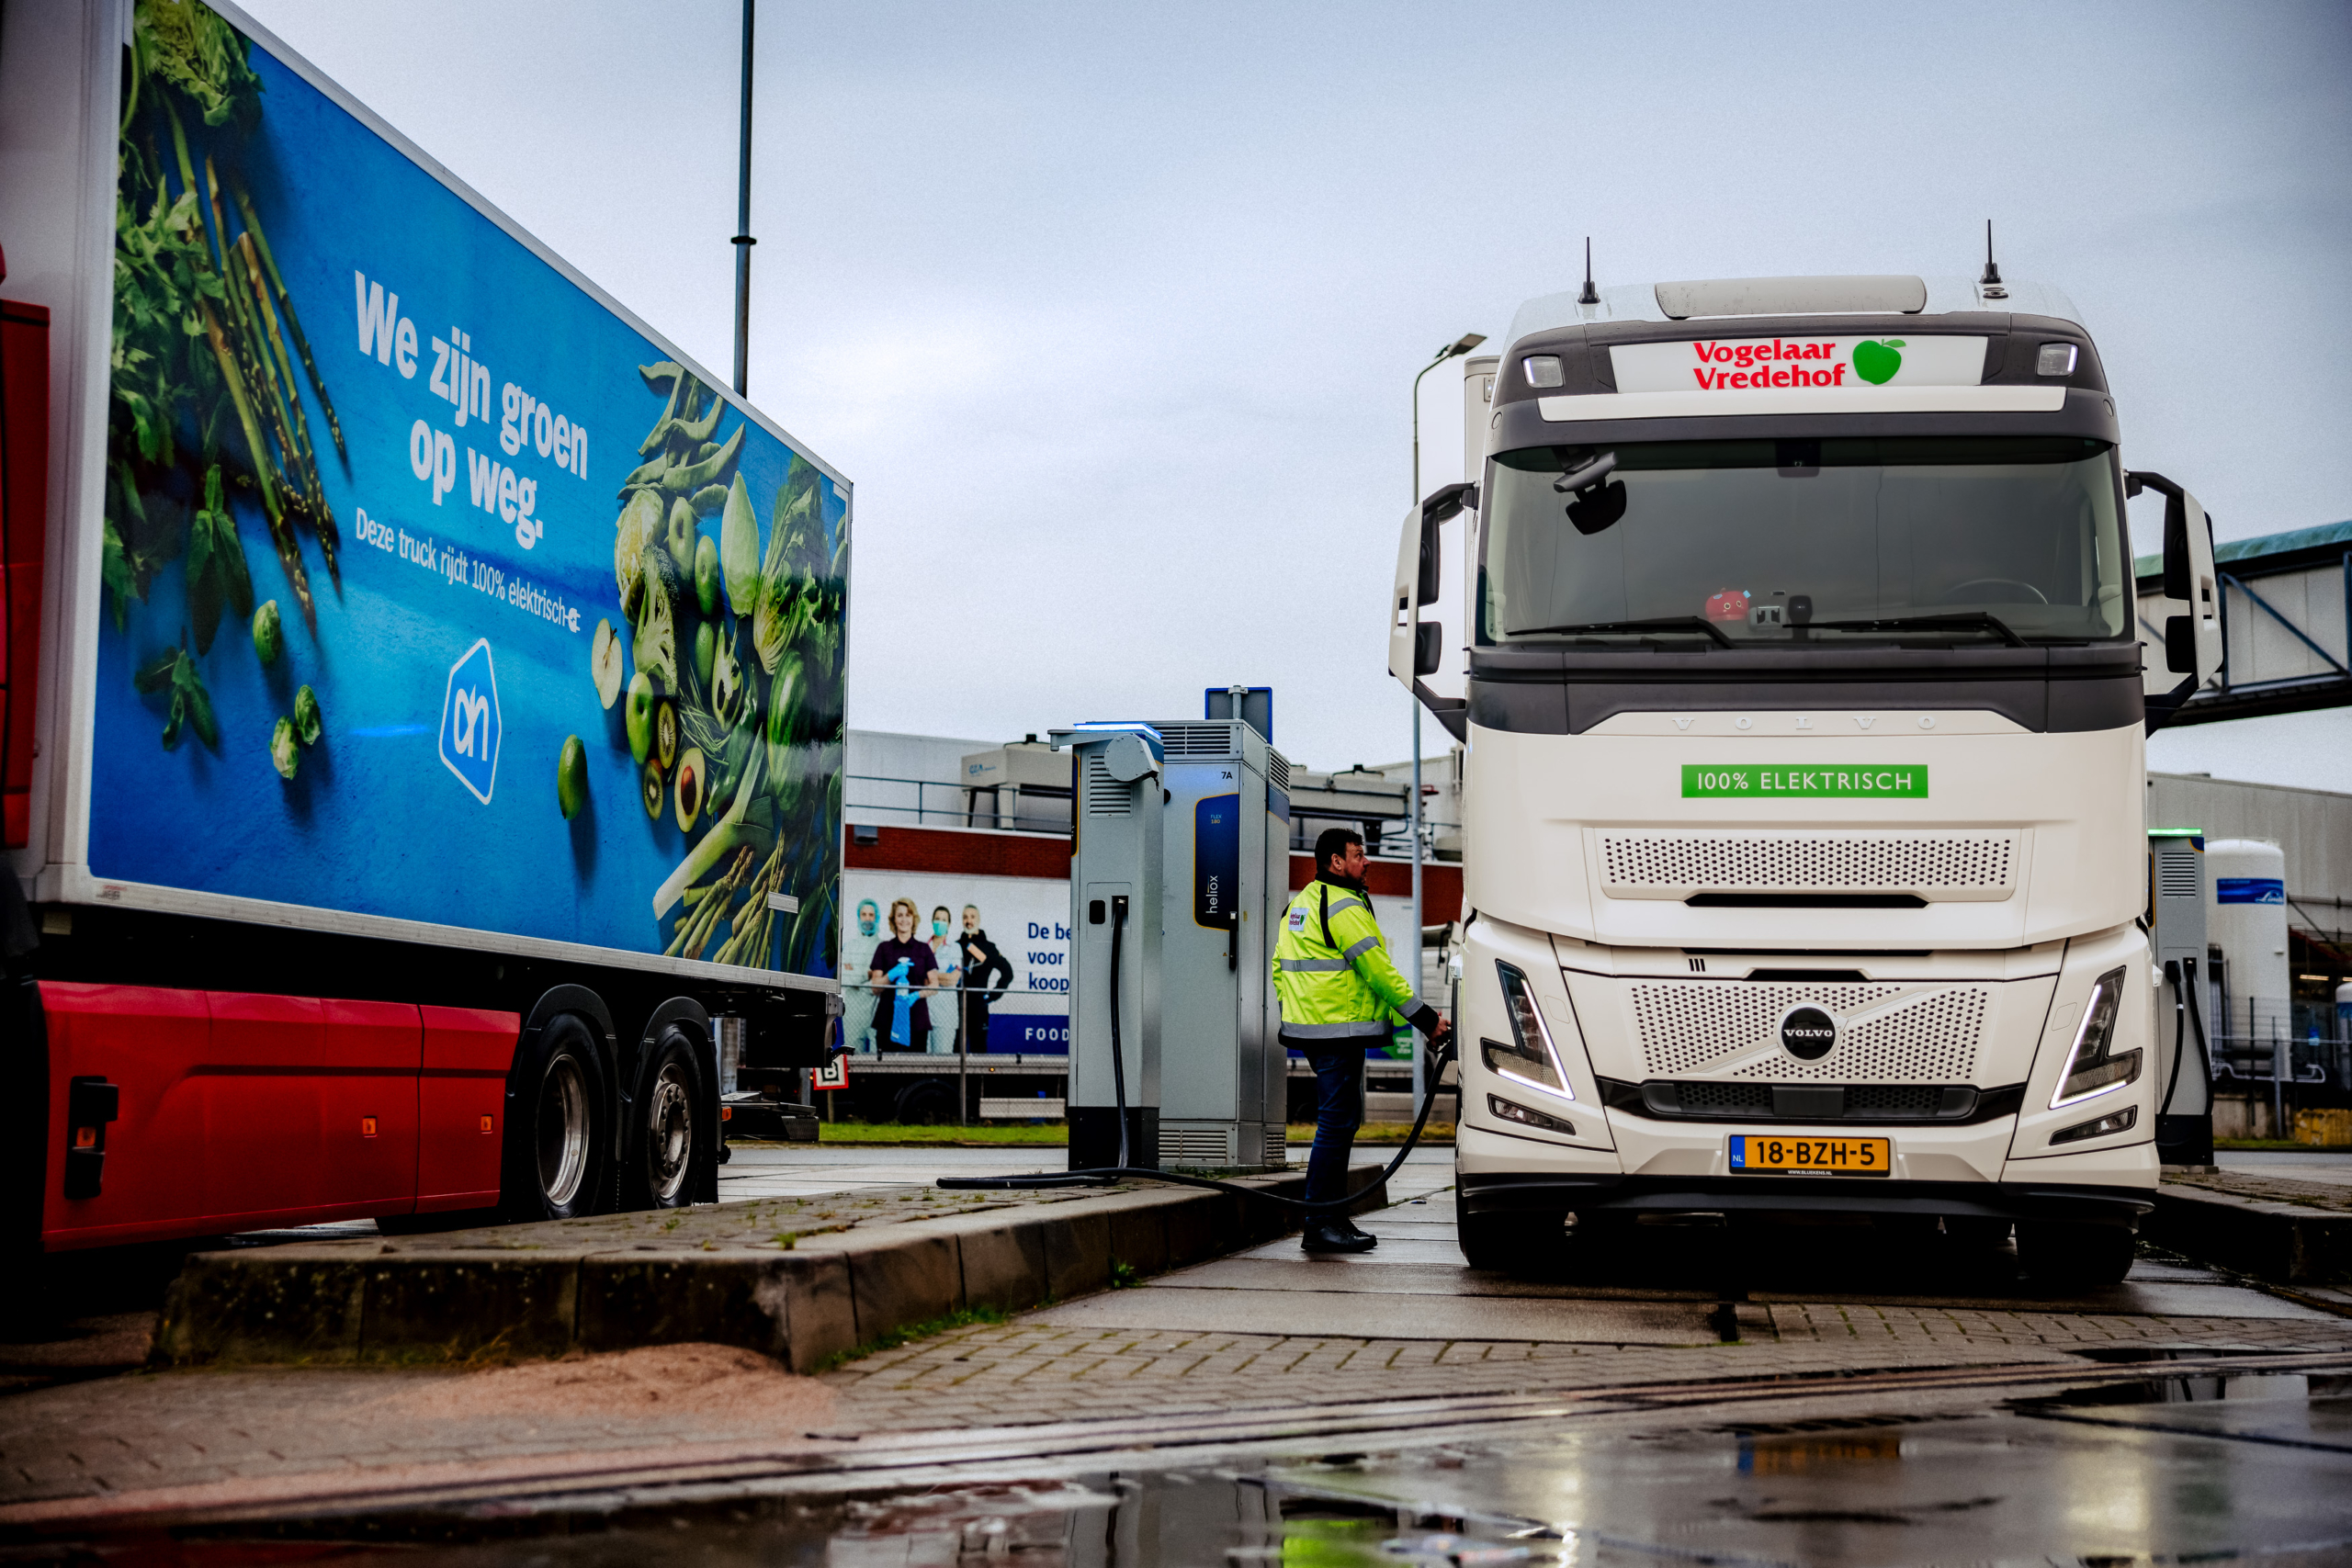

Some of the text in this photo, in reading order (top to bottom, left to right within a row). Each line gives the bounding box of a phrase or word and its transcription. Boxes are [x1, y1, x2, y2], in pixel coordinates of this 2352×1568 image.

[1692, 339, 1837, 367] Vogelaar
[356, 270, 588, 481] We zijn groen
[1692, 363, 1847, 390] Vredehof
[410, 419, 544, 550] op weg.
[356, 507, 566, 627] Deze truck rijdt 100% elektrisch
[1671, 716, 1936, 731] VOLVO
[1221, 771, 1233, 780] 7A
[1697, 772, 1912, 790] 100% ELEKTRISCH
[1205, 874, 1218, 914] heliox
[1027, 922, 1049, 939] De
[1027, 952, 1065, 964] voor
[1028, 972, 1069, 991] koop
[1024, 1027, 1069, 1041] FOOD
[1783, 1029, 1834, 1037] VOLVO
[1757, 1141, 1875, 1166] 18-BZH-5
